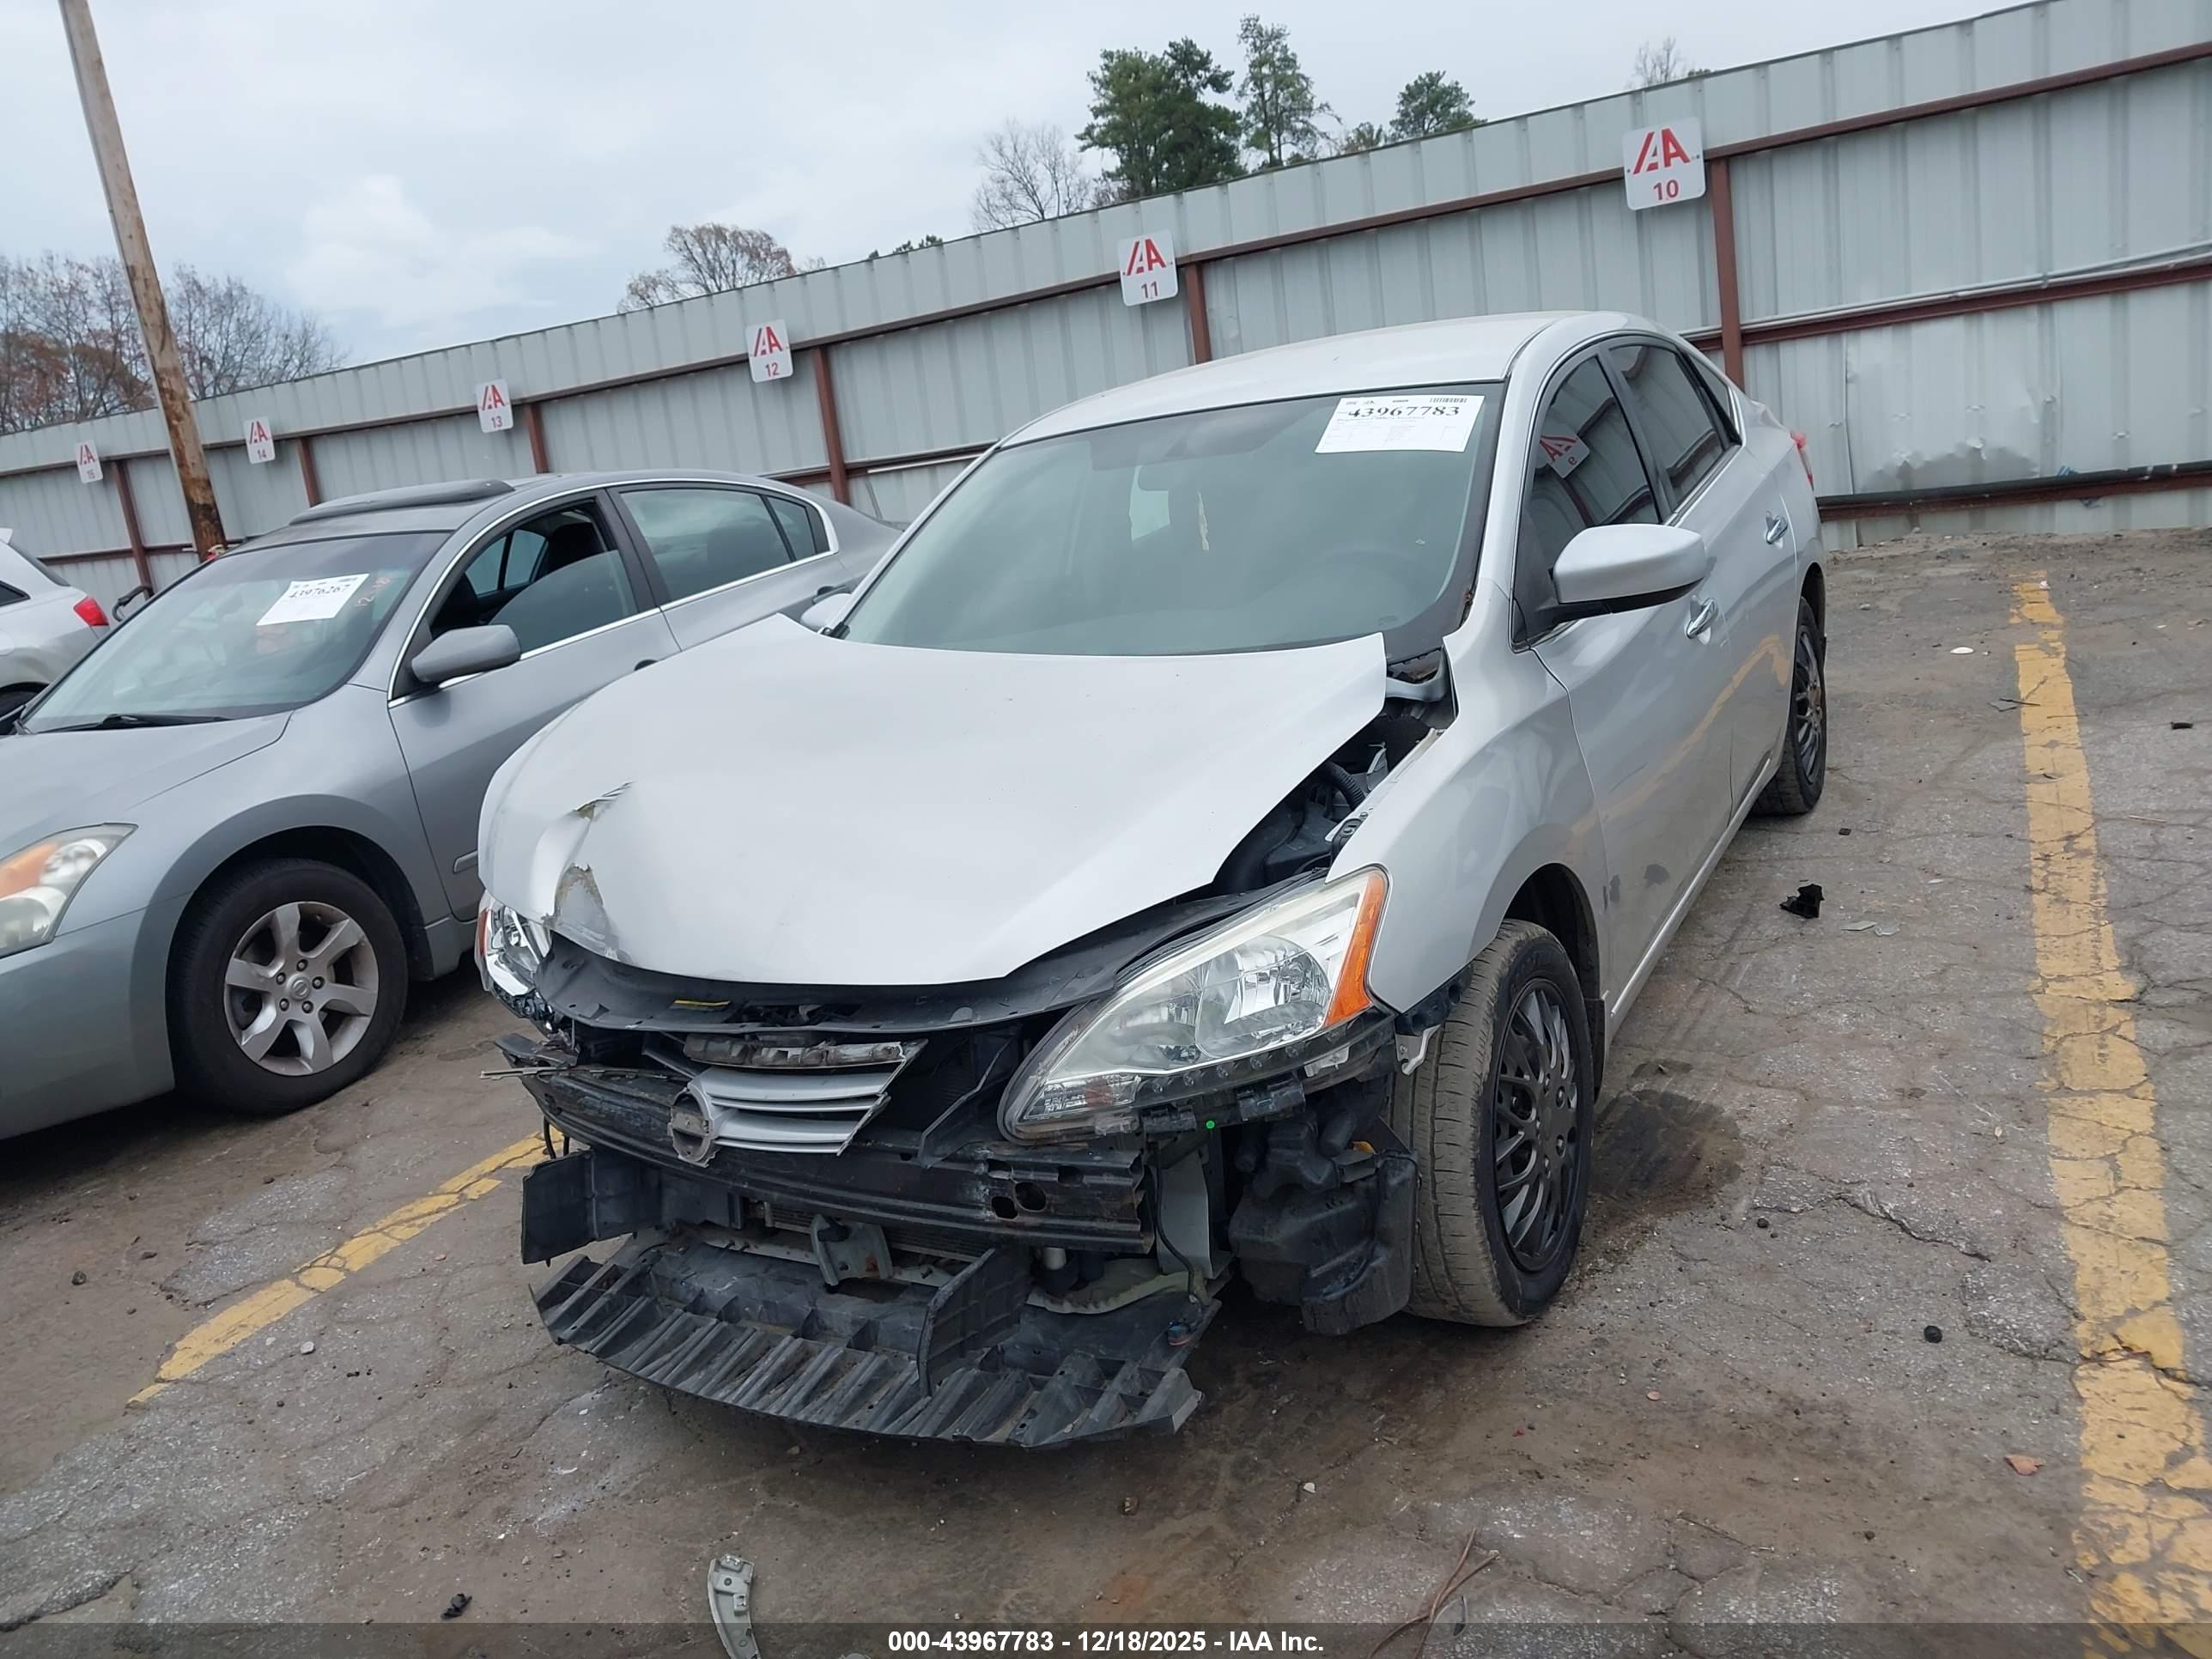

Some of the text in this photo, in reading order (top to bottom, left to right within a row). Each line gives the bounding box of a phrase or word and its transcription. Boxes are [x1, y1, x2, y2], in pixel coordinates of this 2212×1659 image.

[1653, 179, 1680, 201] 10
[1140, 281, 1159, 299] 11
[764, 362, 780, 377] 12
[1347, 405, 1461, 418] 43967783
[490, 416, 503, 428] 13
[257, 448, 268, 459] 14
